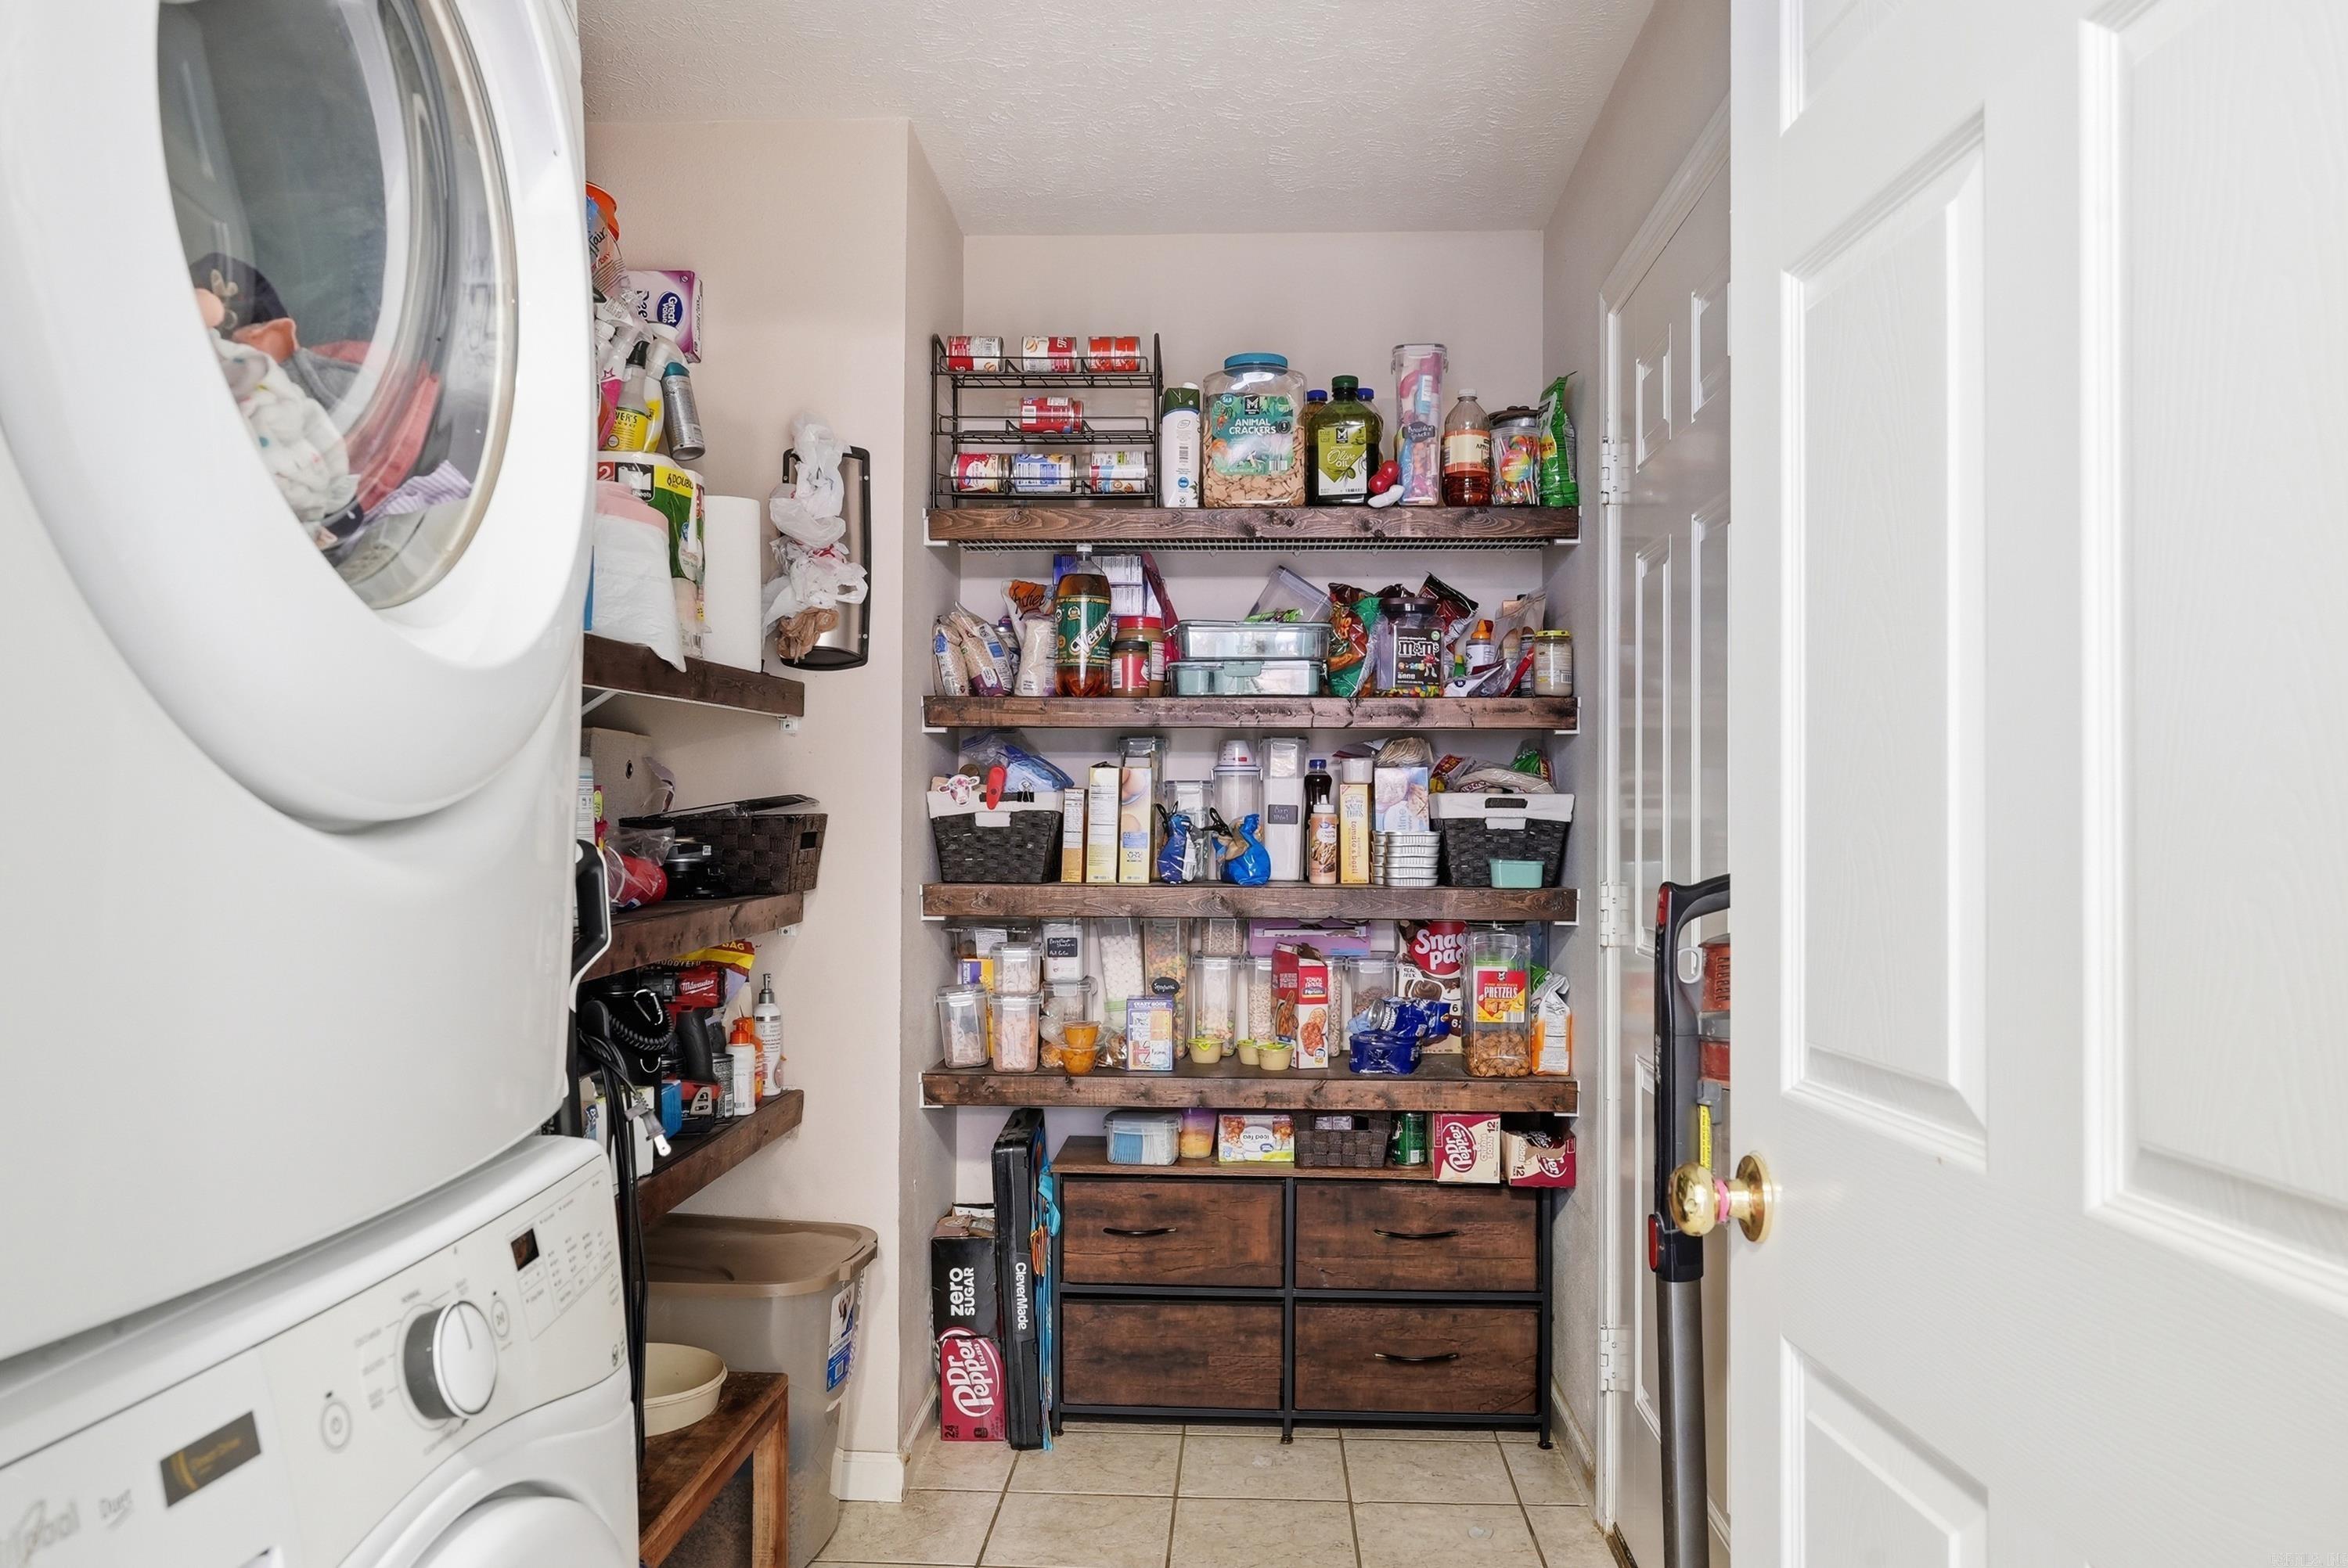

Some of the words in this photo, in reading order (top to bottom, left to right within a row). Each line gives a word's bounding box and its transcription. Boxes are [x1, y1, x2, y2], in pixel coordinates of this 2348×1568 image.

[667, 297, 678, 324] Great
[1235, 418, 1272, 426] ANIMAL
[1229, 426, 1277, 437] CRACKERS
[1327, 449, 1356, 464] Olive
[1484, 986, 1518, 999] PRETZELS
[1451, 1004, 1458, 1012] 6
[1487, 1121, 1496, 1133] 12
[1445, 1137, 1457, 1154] Dr
[1448, 1126, 1473, 1166] Pepper
[1516, 1164, 1525, 1177] 12
[949, 1268, 964, 1316] zero
[964, 1267, 975, 1316] SUGAR
[1015, 1261, 1028, 1331] CleverMade
[945, 1354, 966, 1386] Dr
[952, 1338, 995, 1413] Pepper
[944, 1424, 954, 1438] 24
